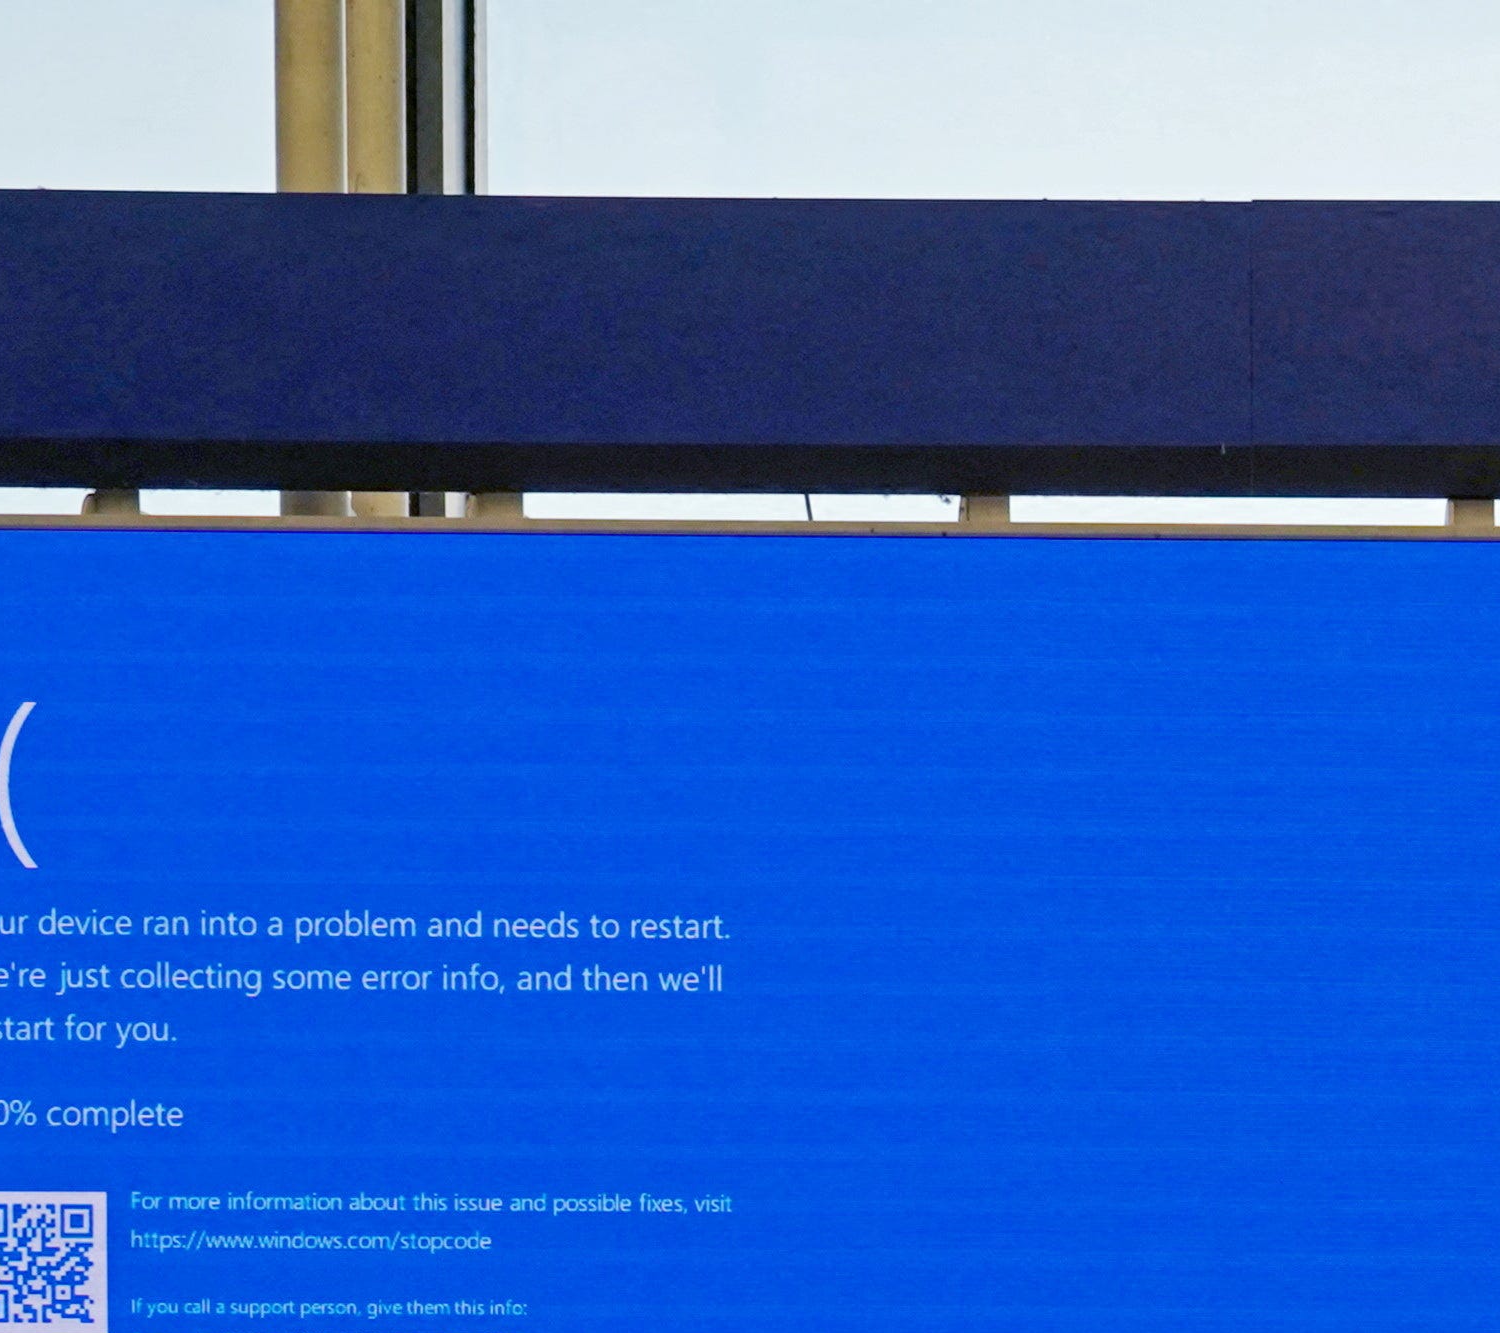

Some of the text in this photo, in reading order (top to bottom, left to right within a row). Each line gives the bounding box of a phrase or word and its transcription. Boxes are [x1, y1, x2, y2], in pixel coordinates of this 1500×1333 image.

[38, 907, 133, 936] device
[143, 915, 190, 936] ran
[200, 909, 258, 937] into
[266, 916, 284, 937] a
[295, 909, 417, 944] problem
[427, 910, 483, 938] and
[493, 910, 580, 939] needs
[589, 914, 620, 939] to
[630, 915, 731, 940] restart.
[55, 961, 112, 996] just
[119, 961, 263, 998] collecting
[272, 969, 352, 991] some
[361, 969, 433, 991] error
[442, 962, 505, 995] info,
[516, 963, 572, 992] and
[581, 963, 648, 992] then
[658, 963, 723, 992] we'll
[64, 1013, 107, 1042] for
[115, 1021, 177, 1050] you.
[46, 1098, 184, 1134] complete
[131, 1190, 733, 1217] For more information about this issue and possible fixes, visit
[130, 1229, 493, 1255] https://www.windows.com/stopcode
[131, 1297, 528, 1320] If you call a support person, give them this info:
